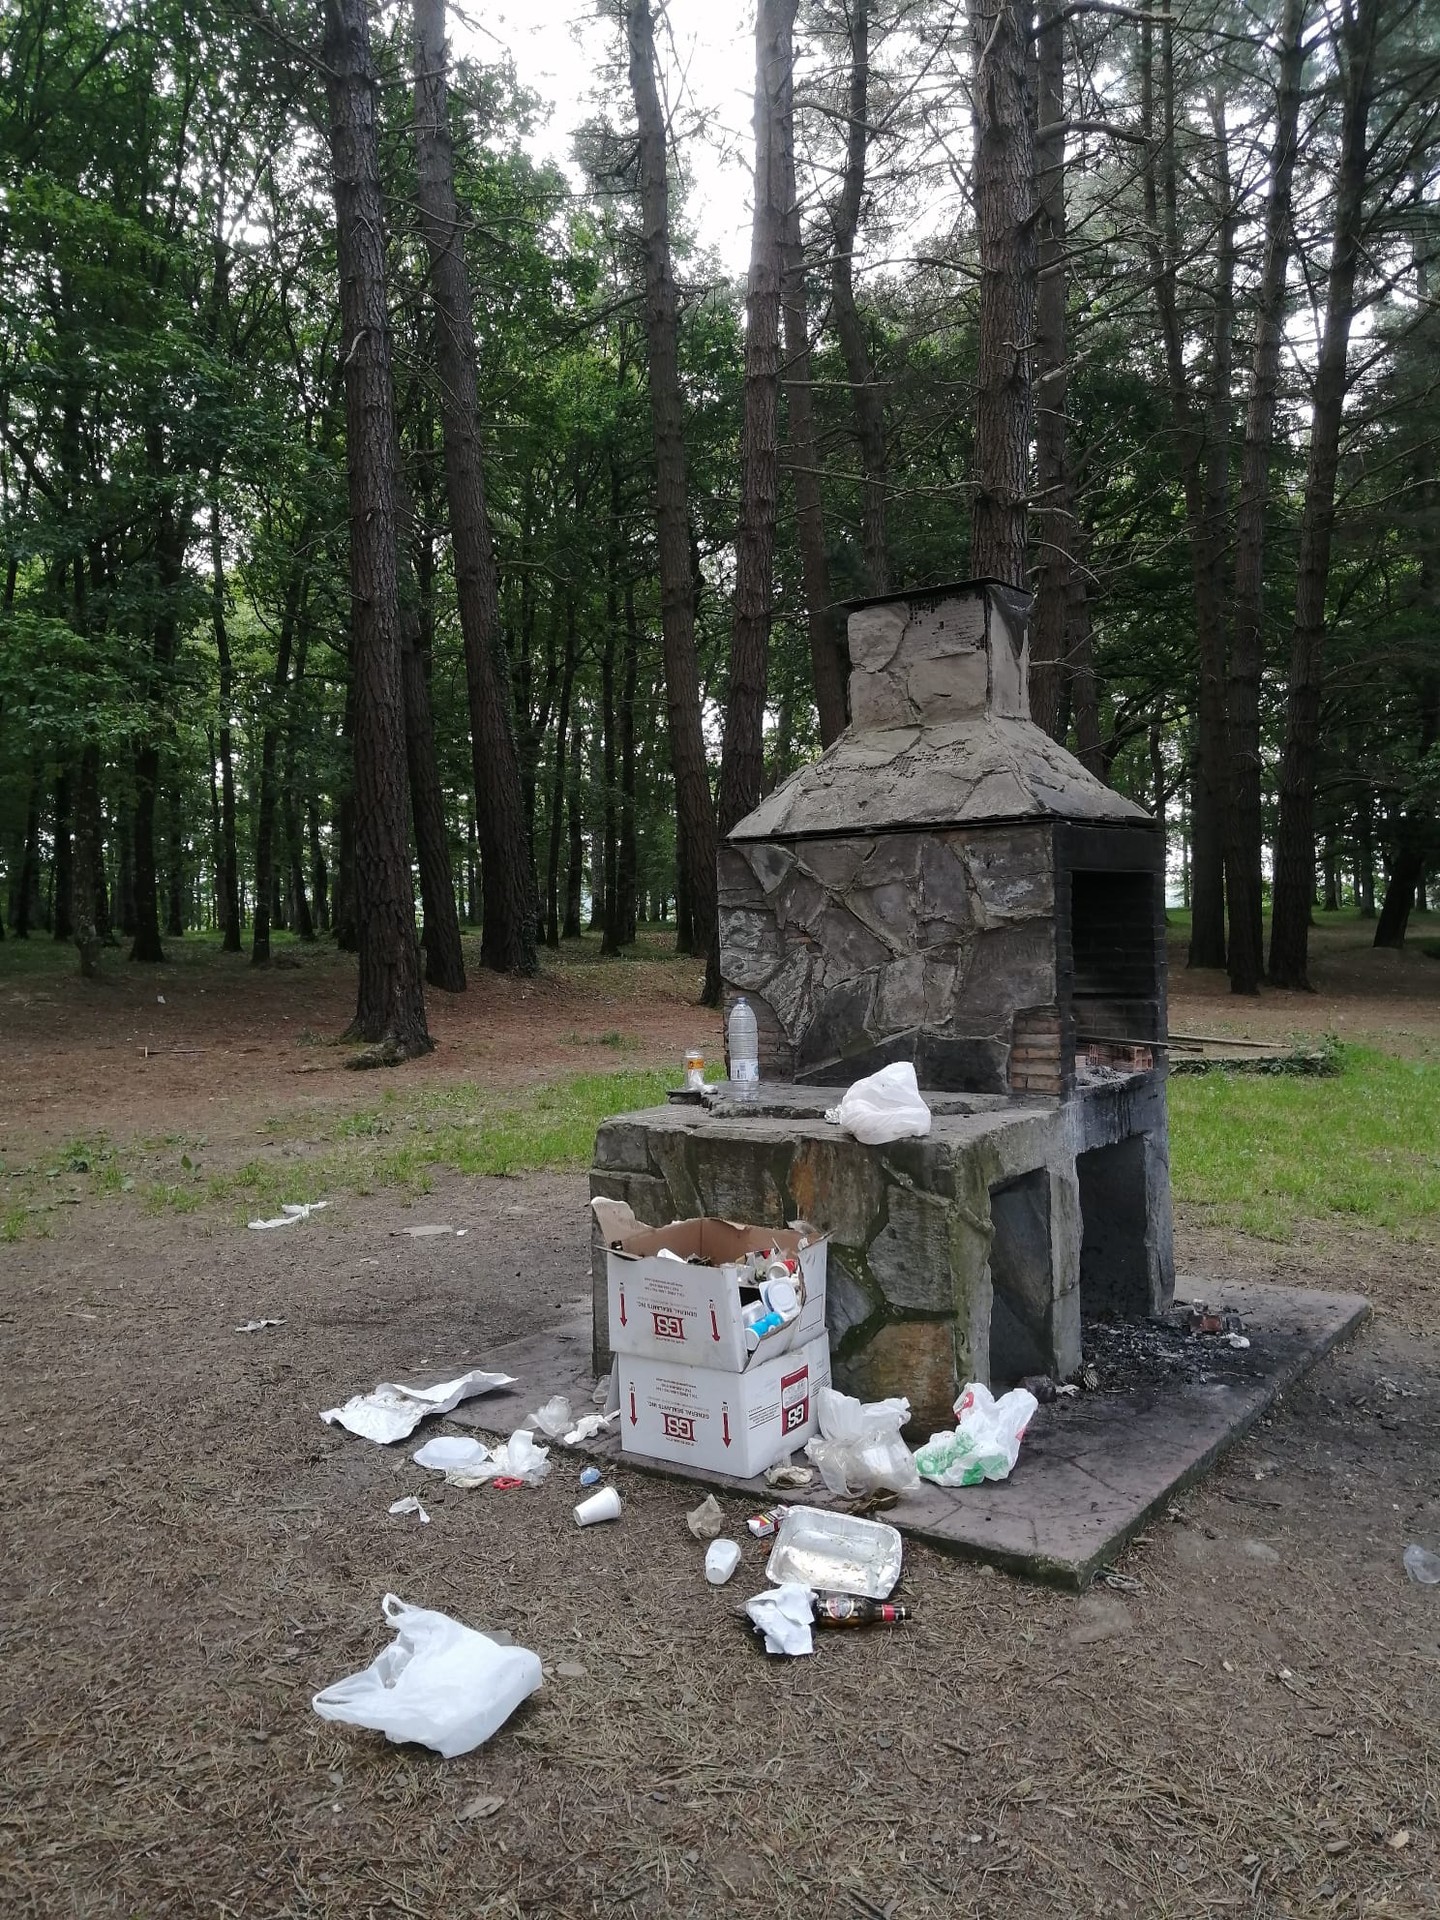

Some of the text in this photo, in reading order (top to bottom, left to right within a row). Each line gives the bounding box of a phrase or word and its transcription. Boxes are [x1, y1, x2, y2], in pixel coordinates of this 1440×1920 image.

[647, 1303, 673, 1314] SEALANTS
[673, 1307, 698, 1318] GENERAL
[657, 1403, 684, 1415] SEALANTS
[684, 1408, 710, 1420] GENERAL
